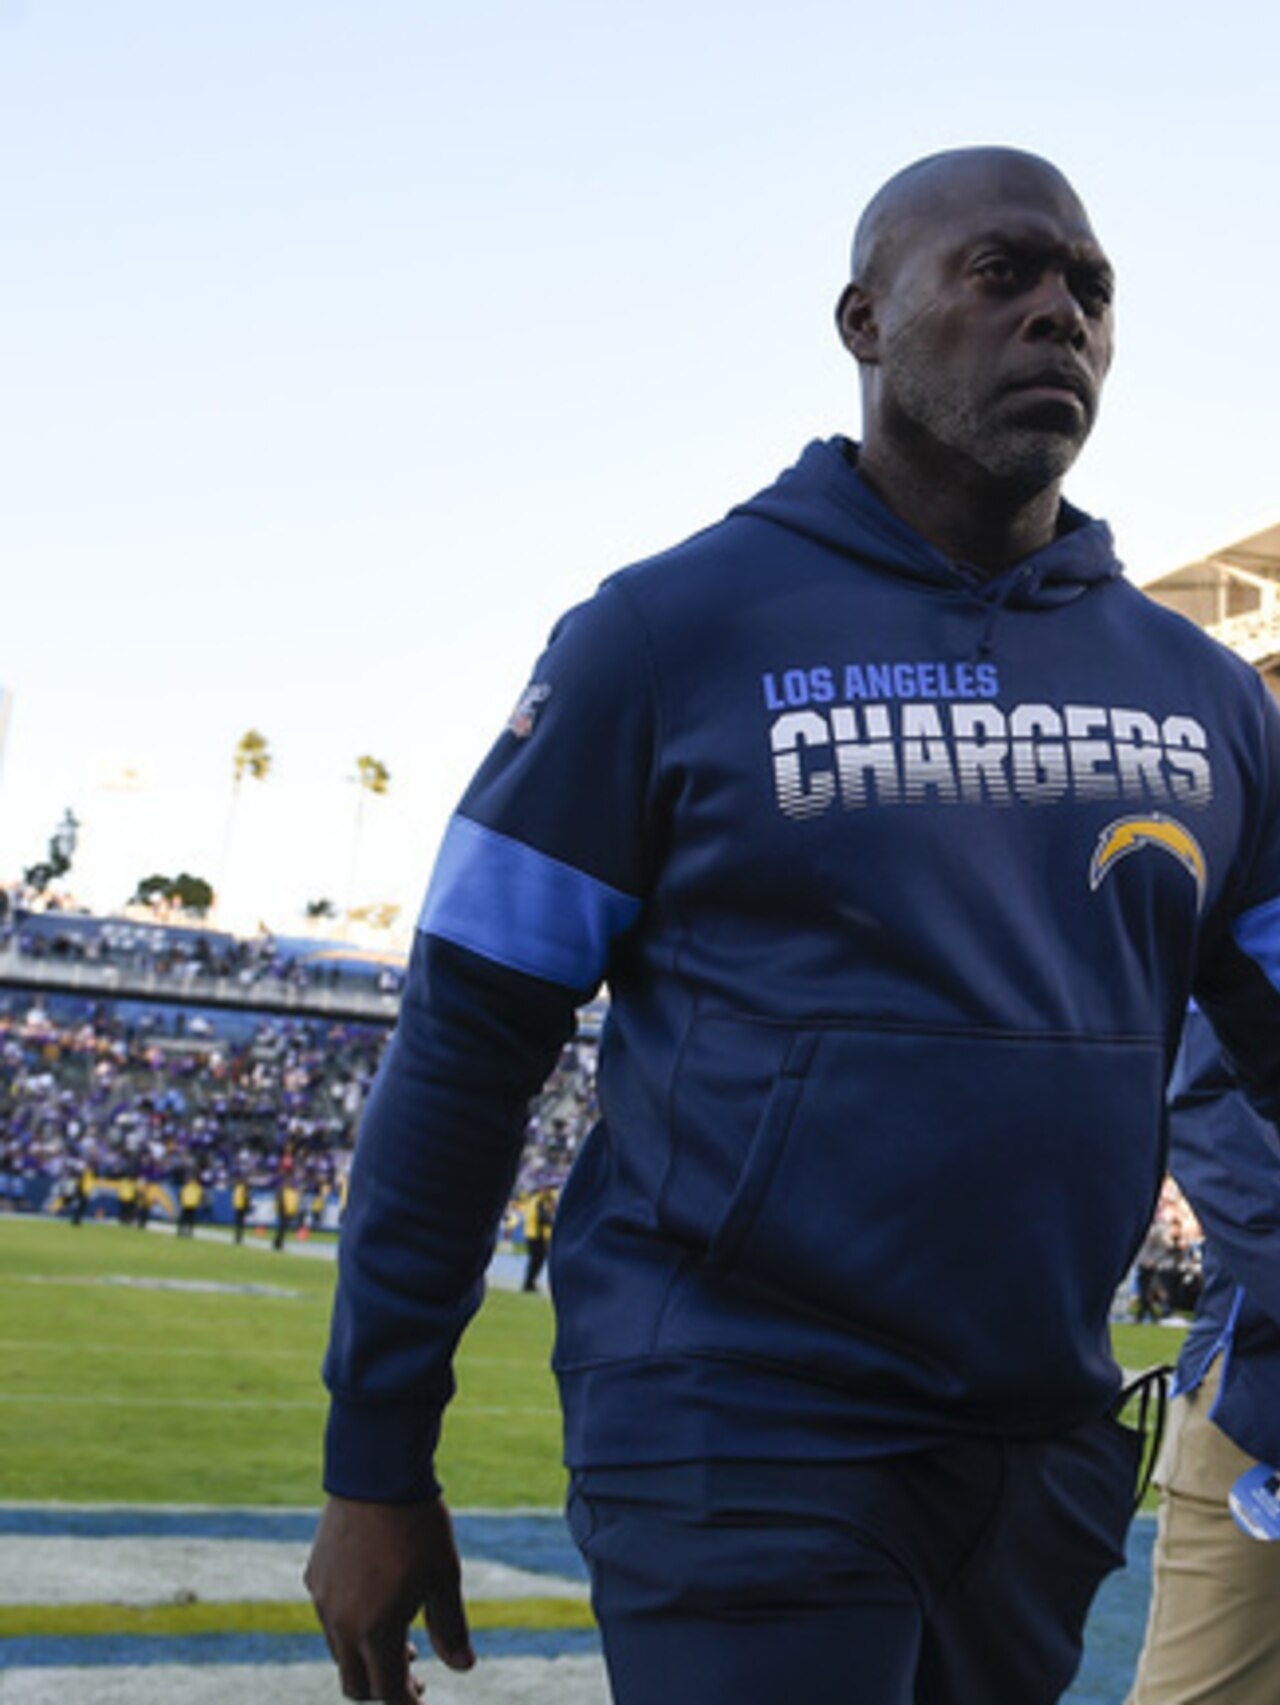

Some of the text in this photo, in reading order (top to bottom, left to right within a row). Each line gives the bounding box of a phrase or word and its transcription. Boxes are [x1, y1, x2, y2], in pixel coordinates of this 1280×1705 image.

[763, 663, 999, 709] LOS ANGELES
[769, 704, 1214, 820] CHARGERS
